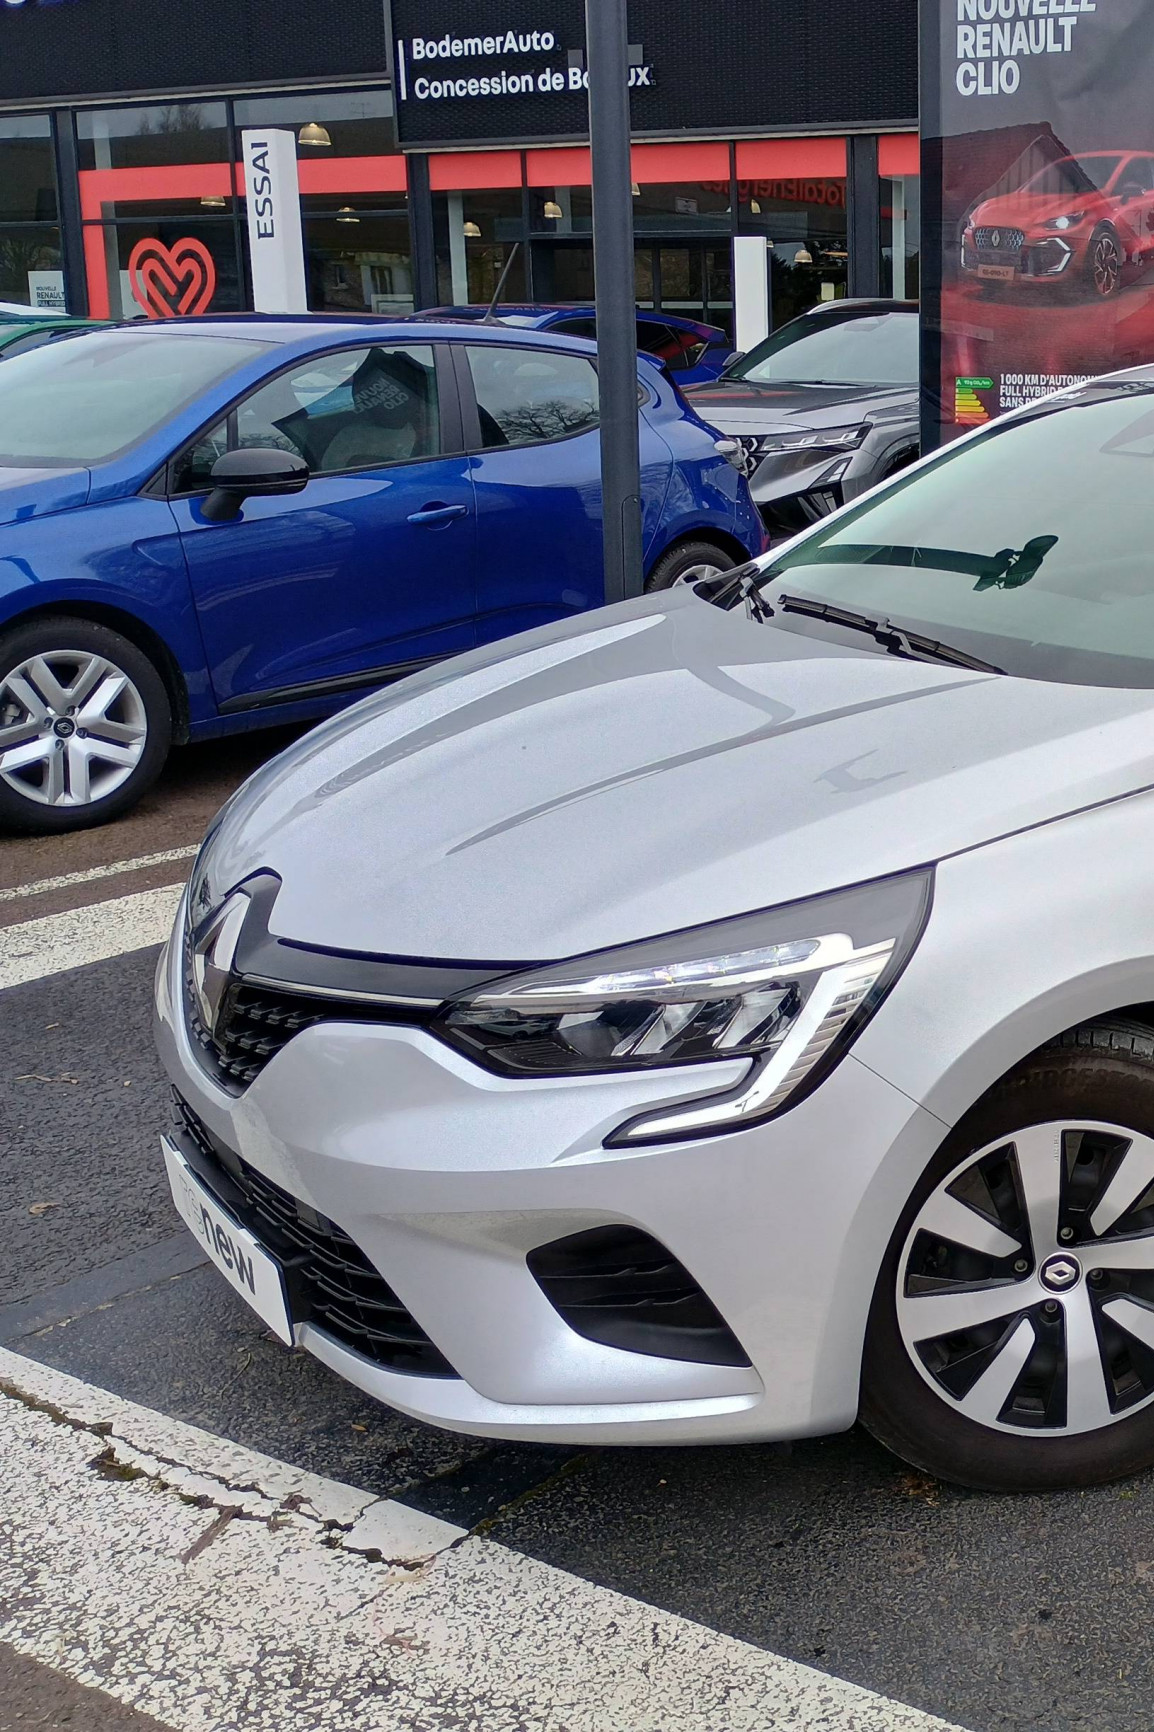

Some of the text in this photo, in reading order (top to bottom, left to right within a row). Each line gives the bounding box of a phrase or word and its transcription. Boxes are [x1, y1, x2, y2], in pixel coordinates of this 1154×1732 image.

[412, 30, 555, 60] BodemerAuto
[956, 16, 1077, 59] RENAULT
[414, 70, 533, 100] Concession
[537, 68, 565, 91] de
[956, 59, 1020, 96] CLIO
[250, 142, 275, 239] ESSAI
[1000, 385, 1056, 397] FULL HYBRID
[1025, 374, 1039, 385] KM
[999, 397, 1024, 408] SANS
